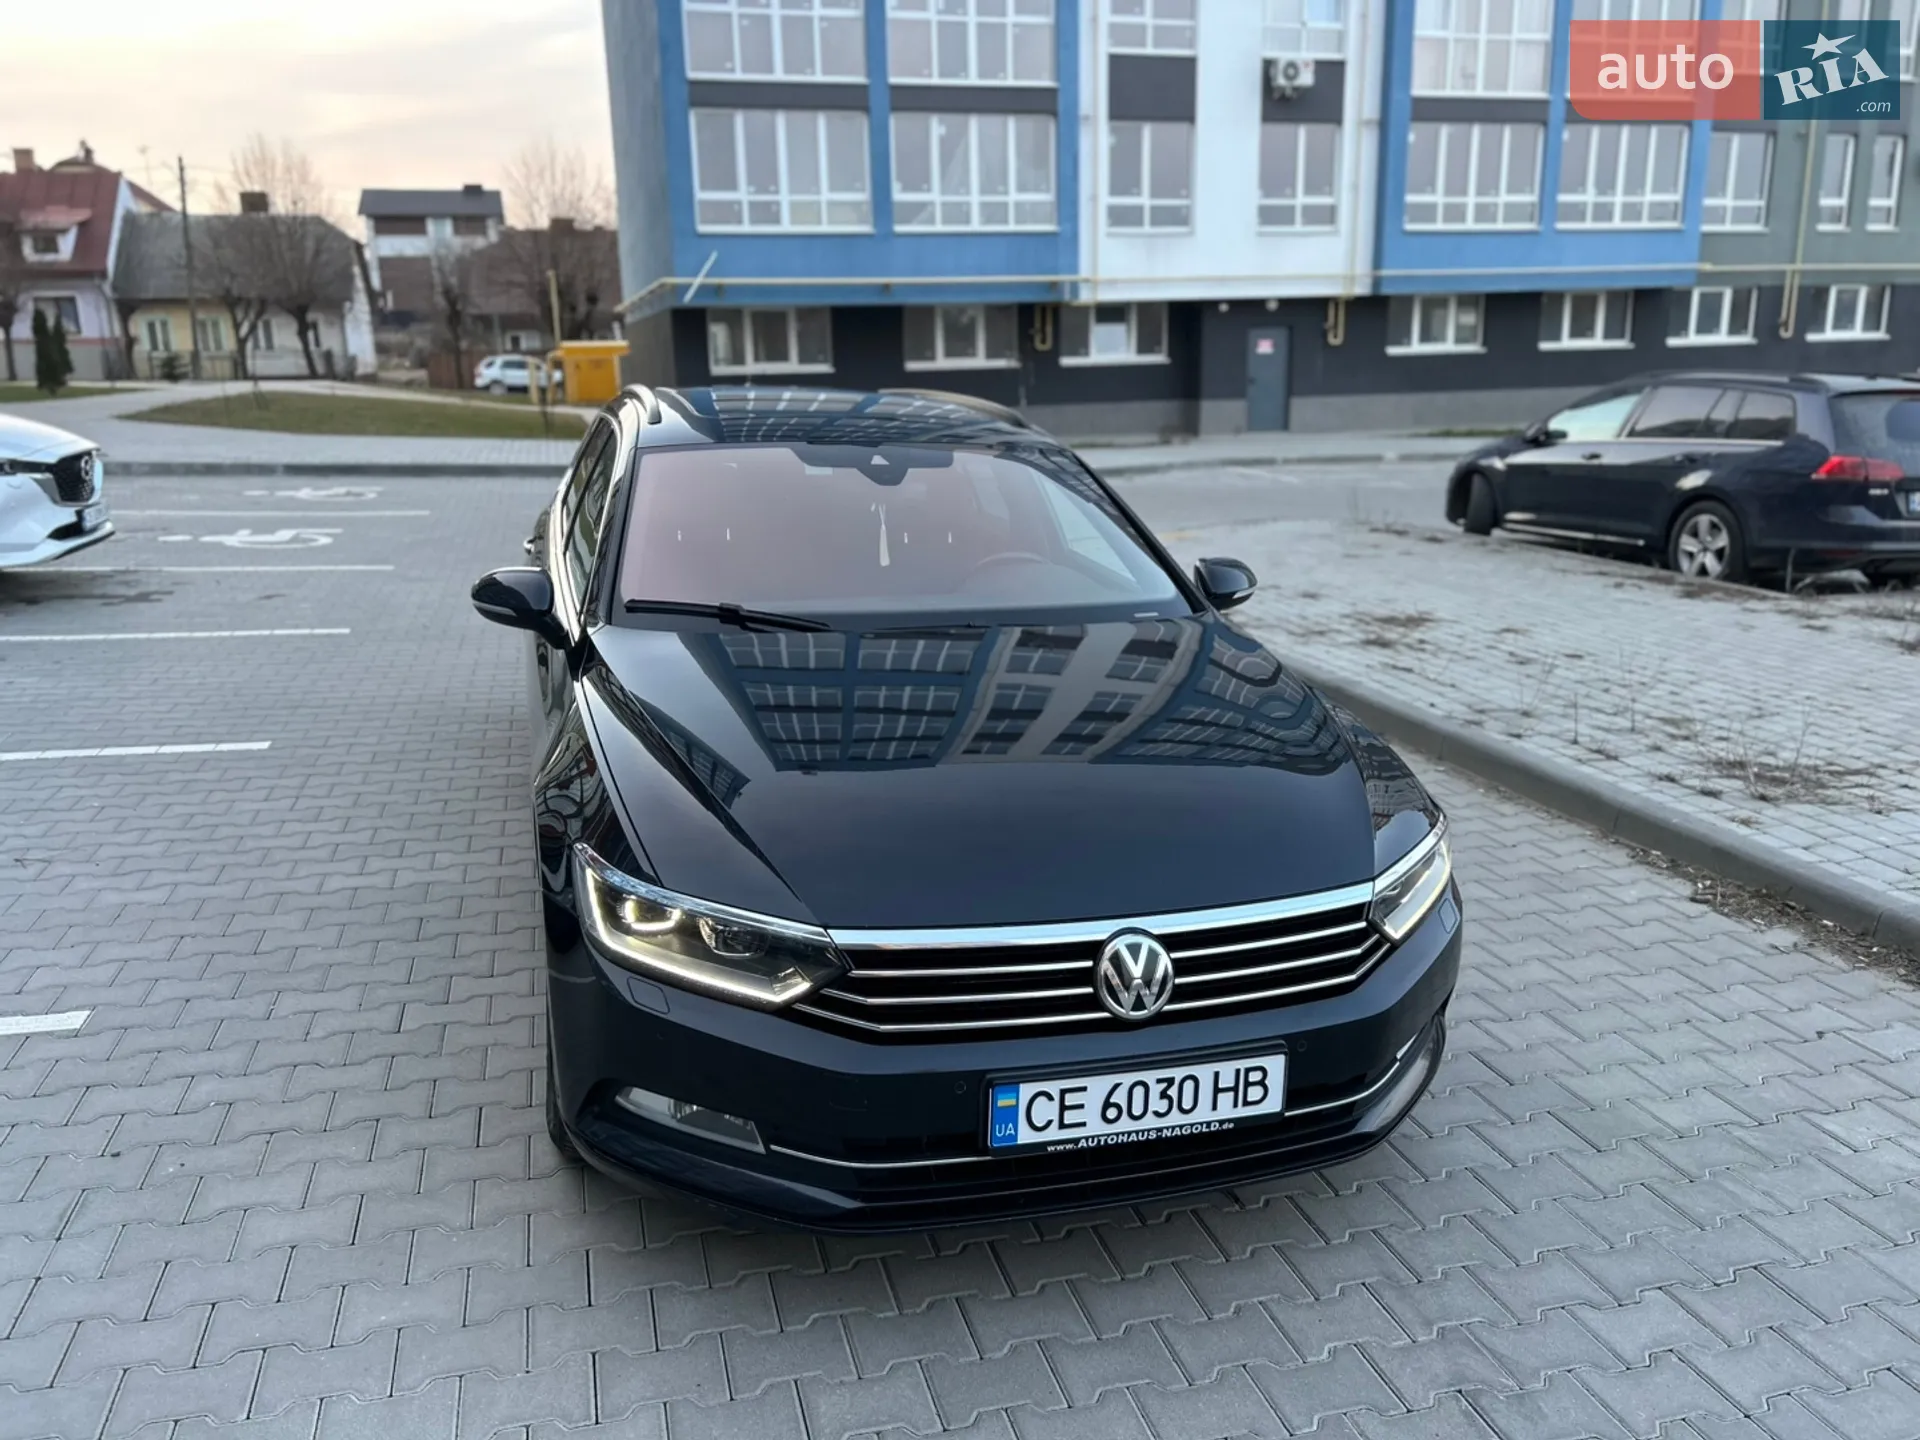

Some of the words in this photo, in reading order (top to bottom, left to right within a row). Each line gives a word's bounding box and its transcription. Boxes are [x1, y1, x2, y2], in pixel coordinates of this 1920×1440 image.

[1025, 1085, 1088, 1132] CE
[1100, 1074, 1200, 1125] 6030
[1211, 1065, 1270, 1112] HB
[995, 1121, 1016, 1138] UA
[1047, 1121, 1234, 1152] www.AUTOHAUS-NAGOLD.de
